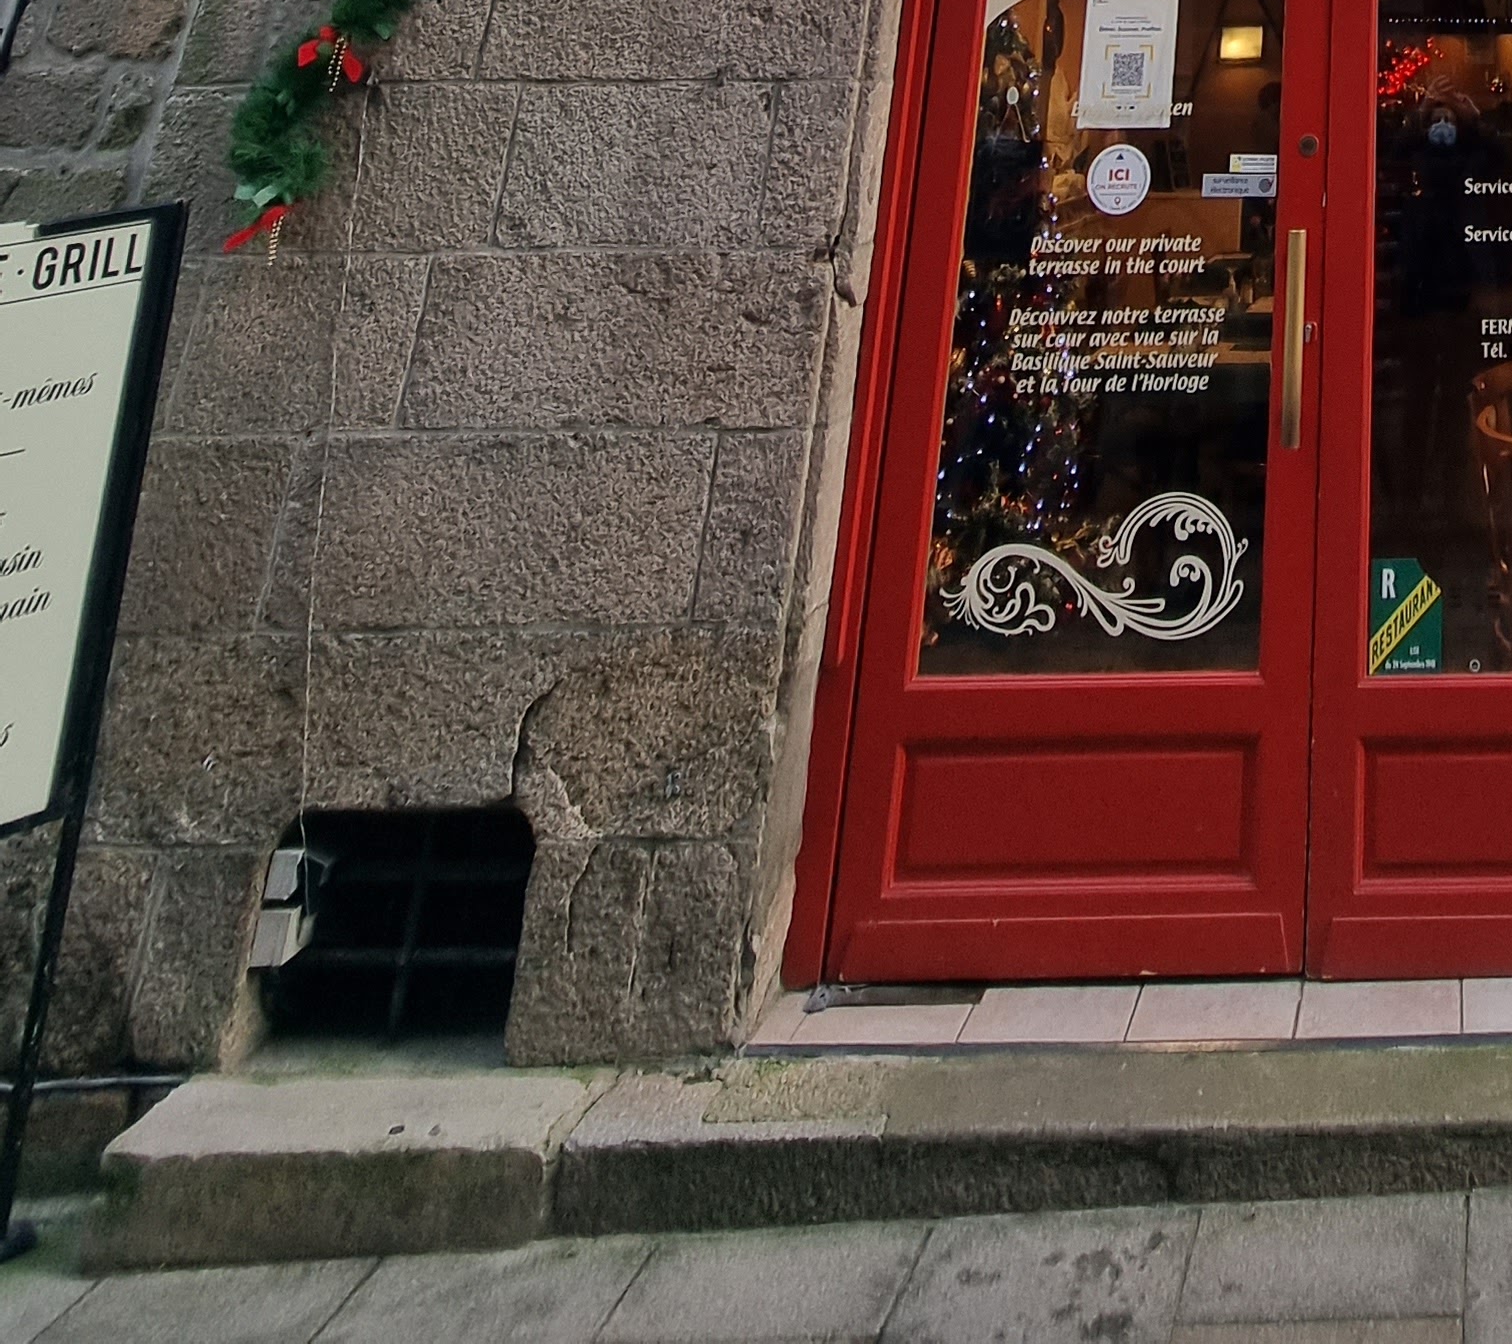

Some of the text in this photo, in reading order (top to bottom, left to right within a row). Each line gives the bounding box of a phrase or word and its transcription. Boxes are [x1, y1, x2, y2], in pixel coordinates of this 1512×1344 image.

[1108, 168, 1130, 181] ICI
[1030, 233, 1202, 256] Discover our private
[32, 233, 143, 291] GRILL
[1028, 255, 1206, 276] terrasse in the court
[1008, 305, 1226, 326] Découvrez notre terrasse
[1011, 327, 1220, 349] sur cour avec vue sur la
[1011, 349, 1219, 372] Basilique Saint-Sauveur
[1480, 341, 1508, 359] Tél.
[1016, 374, 1036, 394] et
[1039, 373, 1057, 393] la
[1104, 373, 1128, 393] de
[1131, 373, 1210, 394] l'Horloge
[1380, 567, 1397, 600] R
